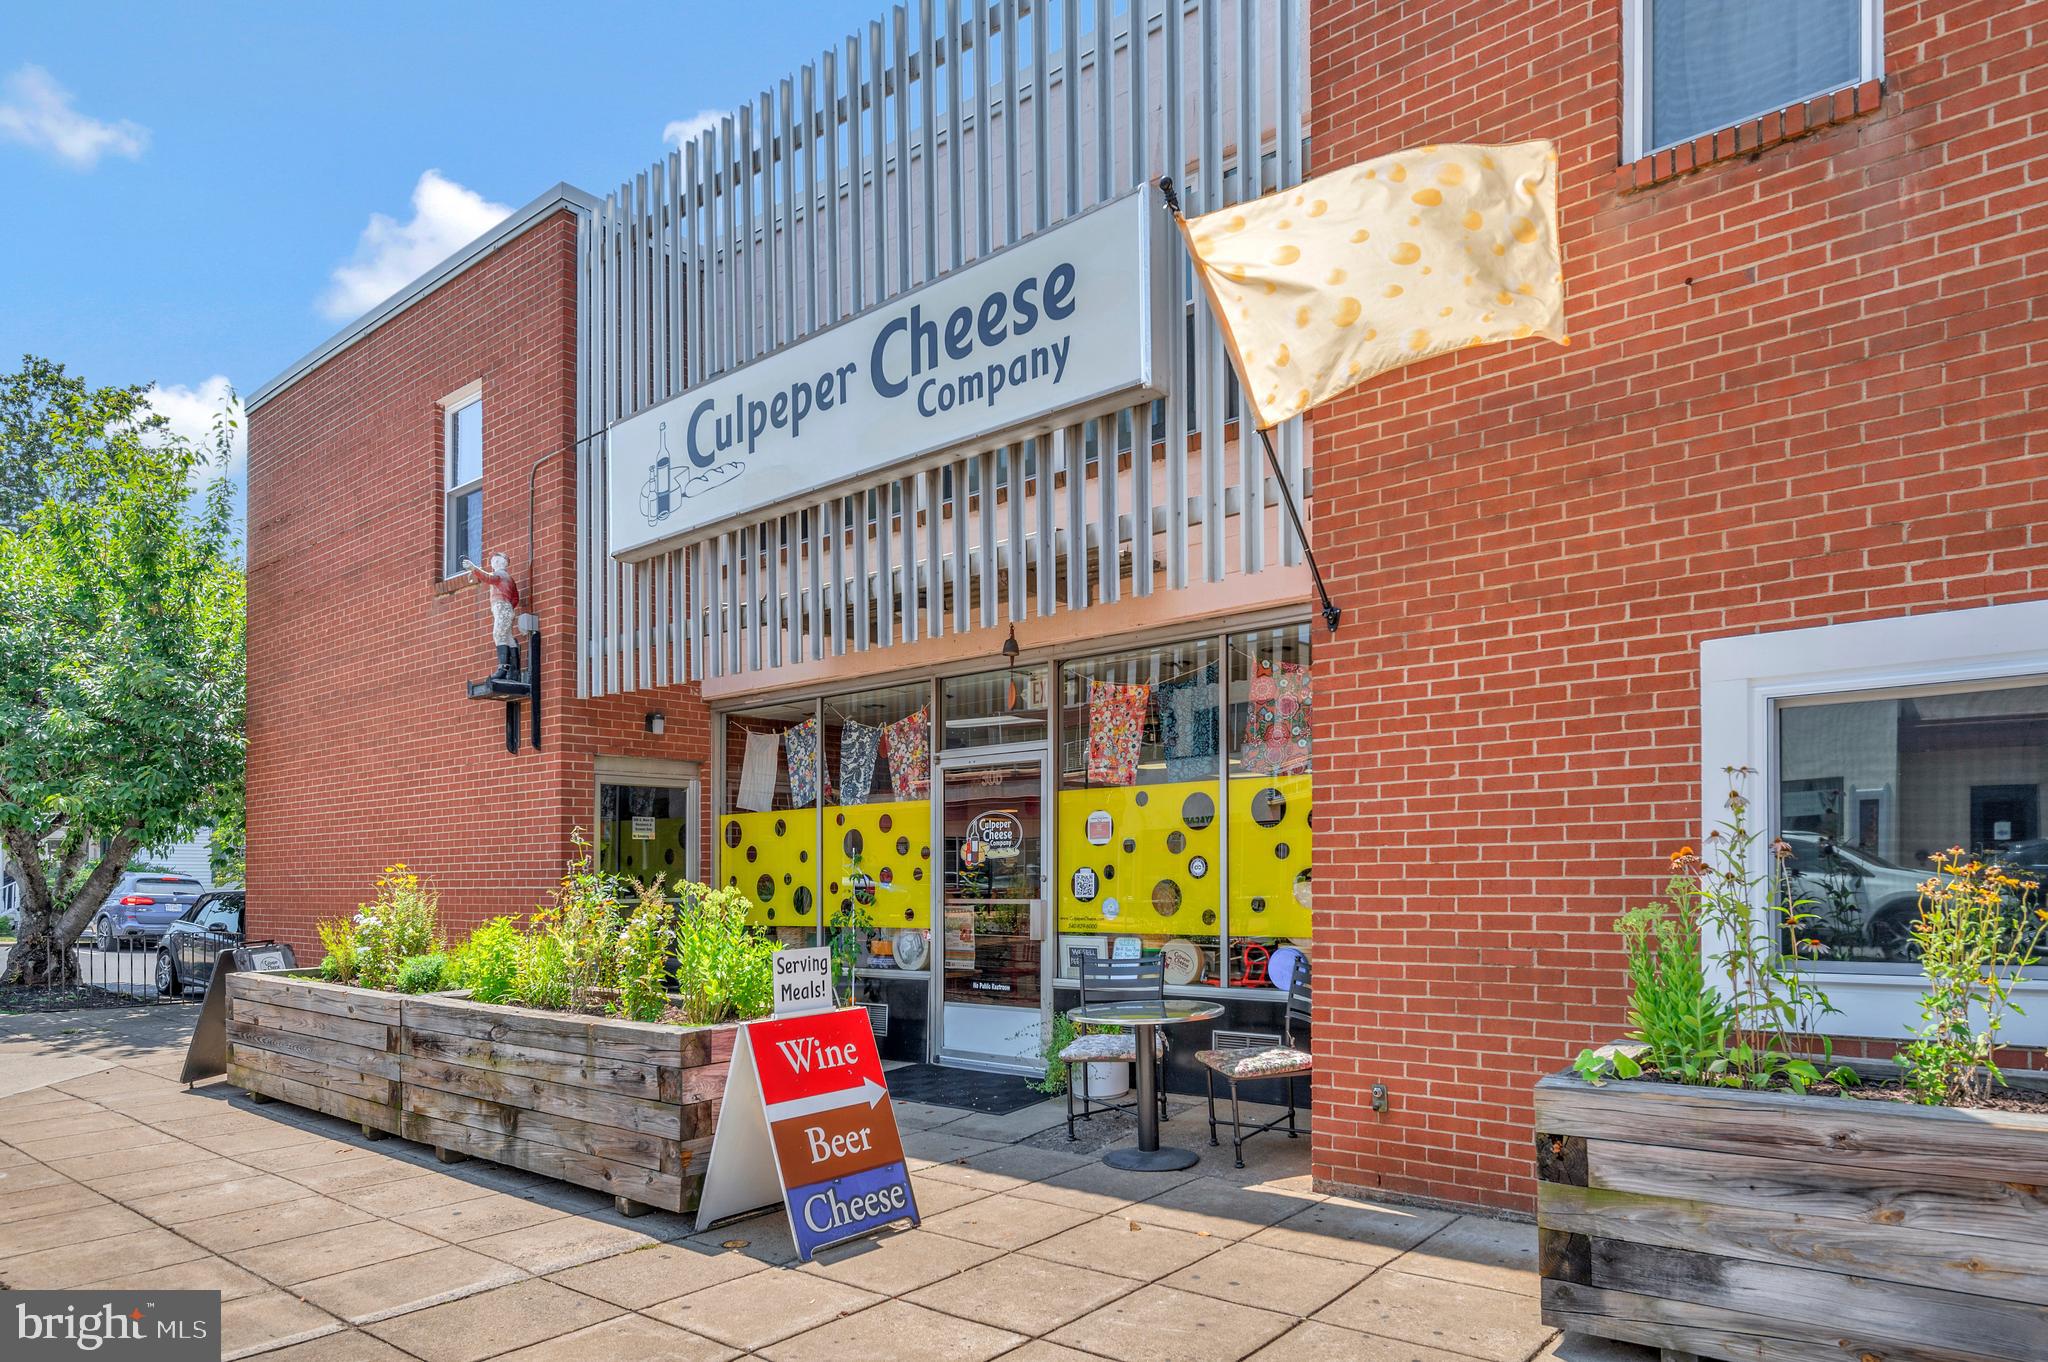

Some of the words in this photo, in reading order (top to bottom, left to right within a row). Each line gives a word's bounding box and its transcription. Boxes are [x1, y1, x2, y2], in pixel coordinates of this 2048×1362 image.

[686, 362, 857, 469] Culpeper
[870, 262, 1076, 399] Cheese
[917, 335, 1071, 418] Company
[979, 818, 1012, 831] Culpeper
[983, 829, 1013, 842] Cheese
[990, 840, 1012, 848] Company
[776, 956, 829, 976] Serving
[780, 980, 826, 1002] Meals!
[776, 1036, 859, 1075] Wine
[804, 1126, 872, 1165] Beer
[803, 1182, 906, 1233] Cheese
